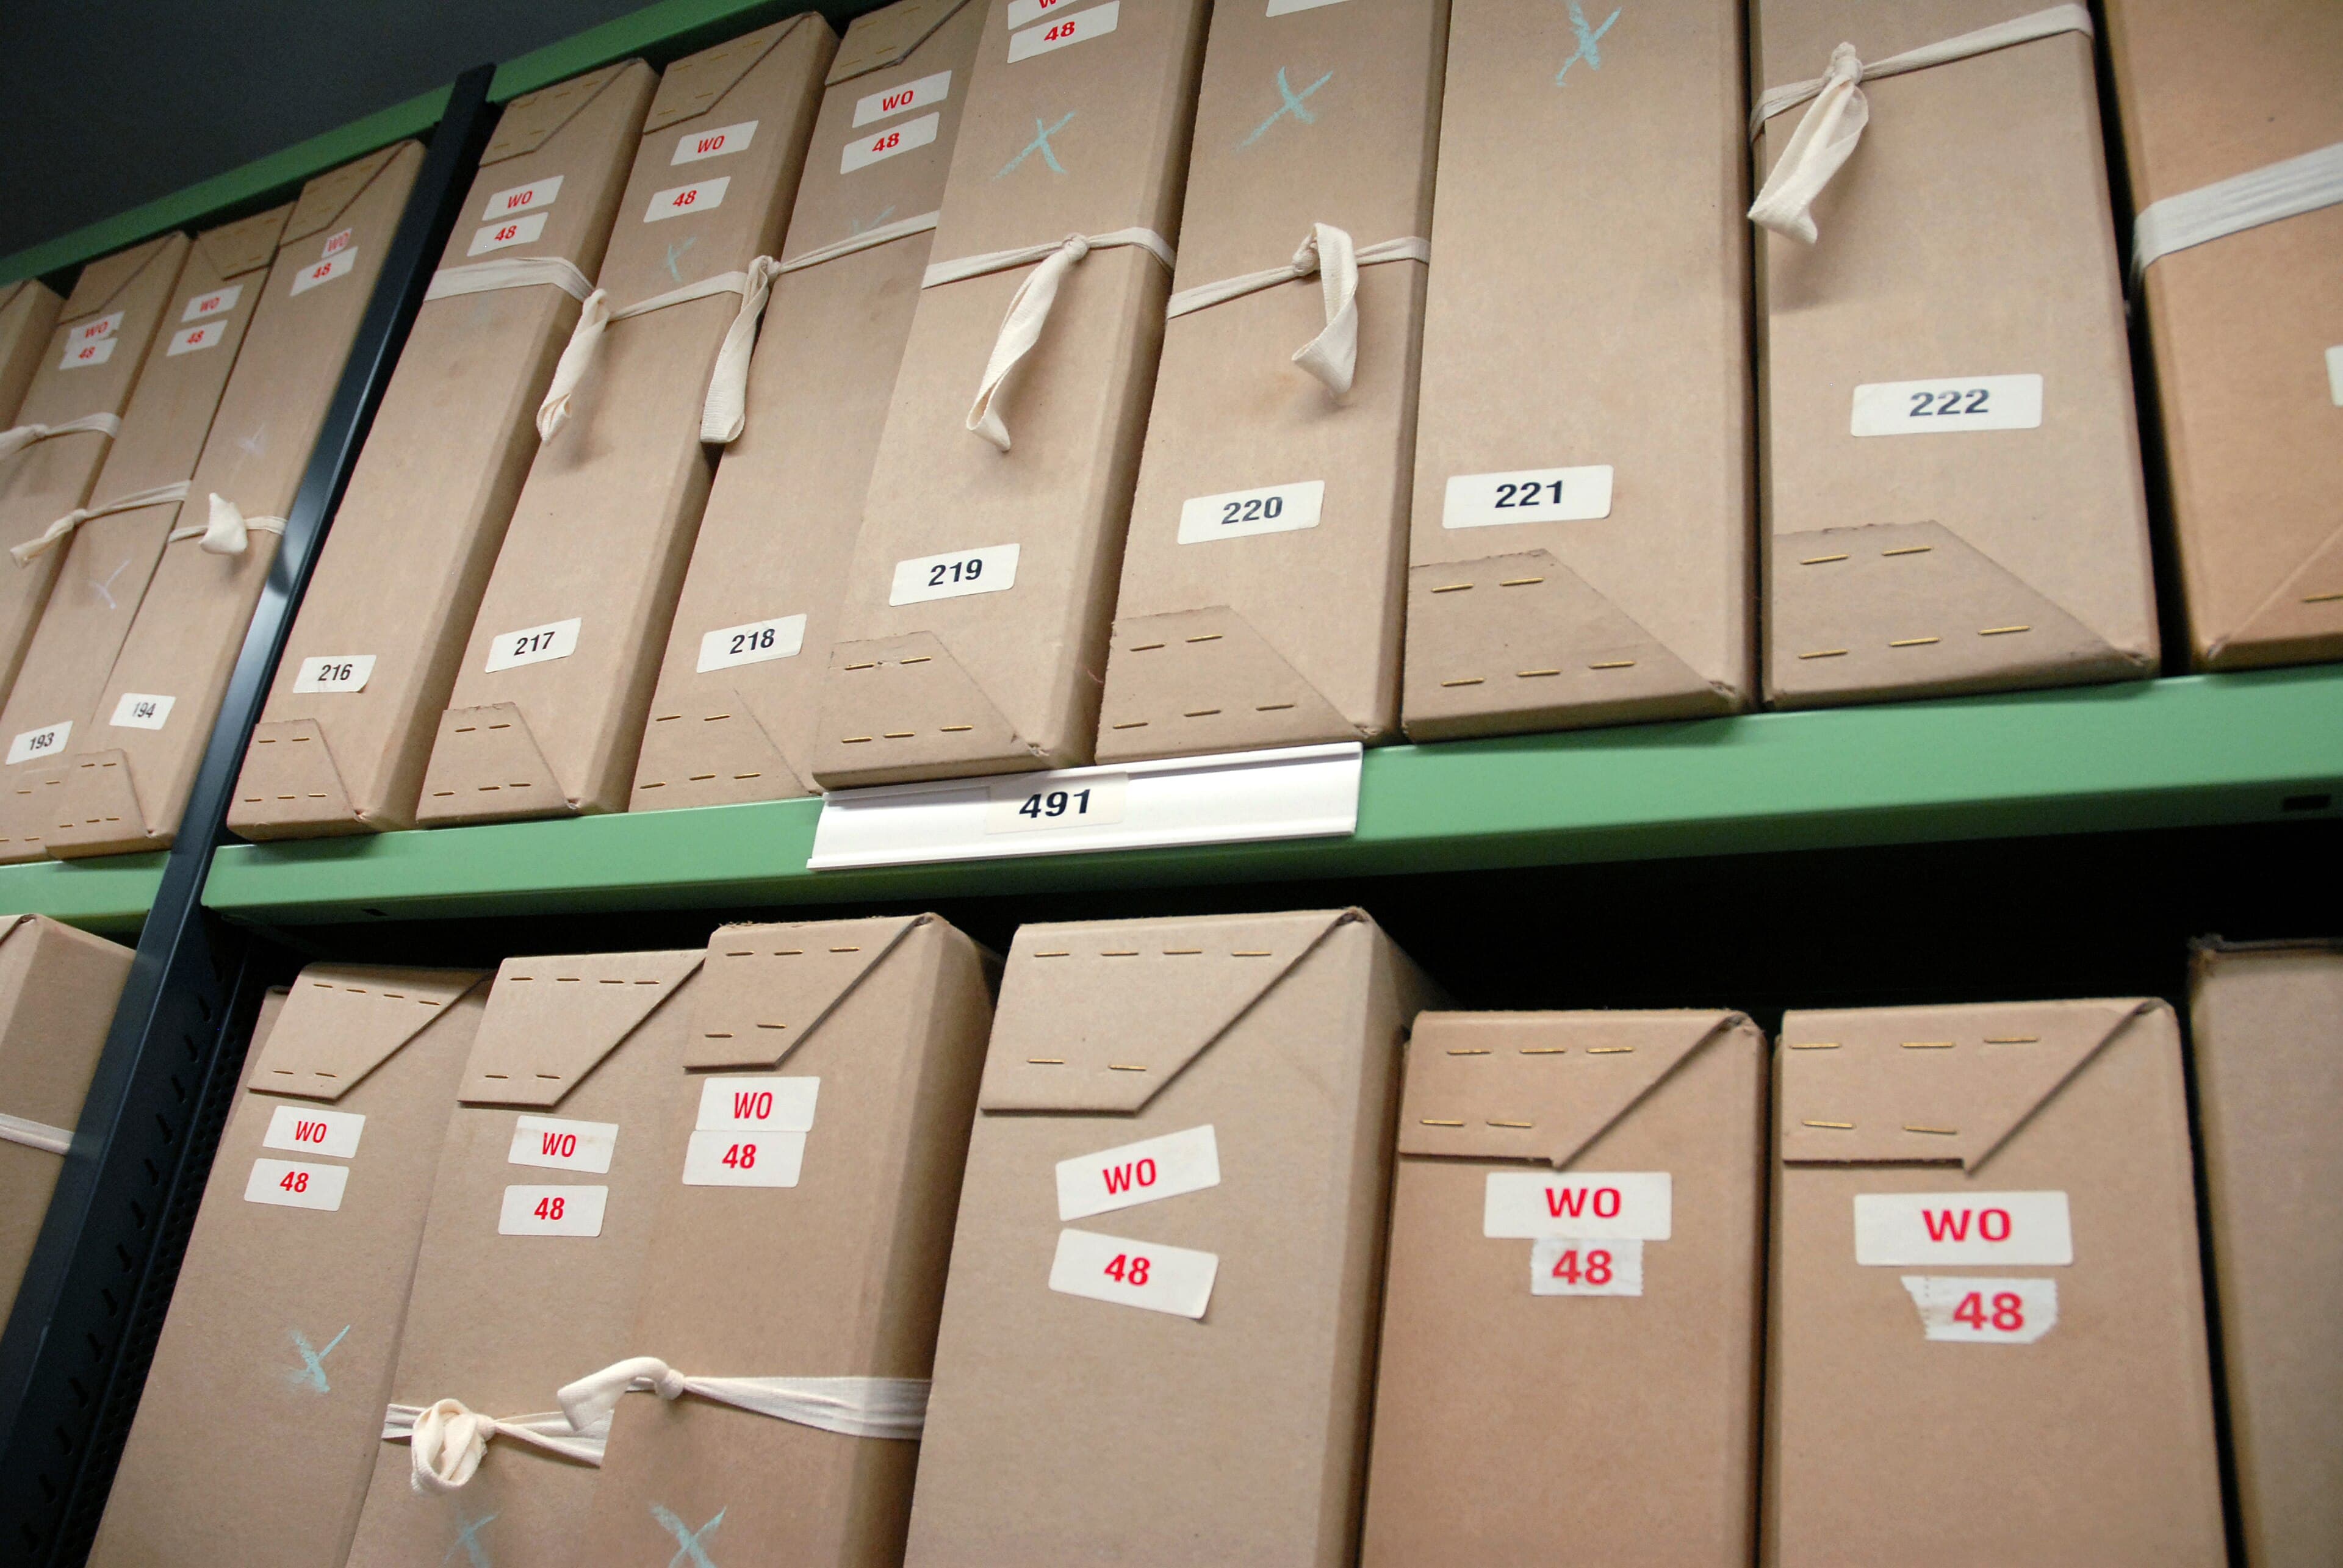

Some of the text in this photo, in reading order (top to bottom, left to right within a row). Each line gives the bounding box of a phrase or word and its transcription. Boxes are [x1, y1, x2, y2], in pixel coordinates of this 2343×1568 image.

[1043, 20, 1076, 42] 48
[881, 89, 915, 113] WO
[697, 135, 726, 154] WO
[871, 131, 901, 153] 48
[507, 190, 534, 209] WO
[672, 189, 698, 207] 48
[494, 225, 518, 242] 48
[312, 262, 333, 279] 48
[200, 297, 221, 312] WO
[84, 320, 109, 339] WO
[186, 329, 206, 345] 48
[78, 345, 97, 360] 48
[1909, 388, 1990, 418] 222
[1494, 479, 1563, 509] 221
[1220, 495, 1284, 526] 220
[927, 558, 984, 588] 219
[513, 631, 555, 656] 217
[729, 628, 776, 655] 218
[317, 663, 353, 682] 216
[132, 702, 156, 719] 194
[29, 732, 55, 751] 193
[1018, 787, 1092, 821] 491
[733, 1091, 774, 1121] WO
[295, 1120, 328, 1145] WO
[542, 1131, 578, 1159] WO
[722, 1143, 758, 1170] 48
[279, 1170, 310, 1194] 48
[1101, 1157, 1158, 1196] WO
[533, 1196, 566, 1221] 48
[1544, 1186, 1622, 1220] WO
[1921, 1207, 2013, 1243] WO
[1103, 1253, 1152, 1287] 48
[1551, 1248, 1614, 1287] 48
[1952, 1290, 2026, 1333] 48
